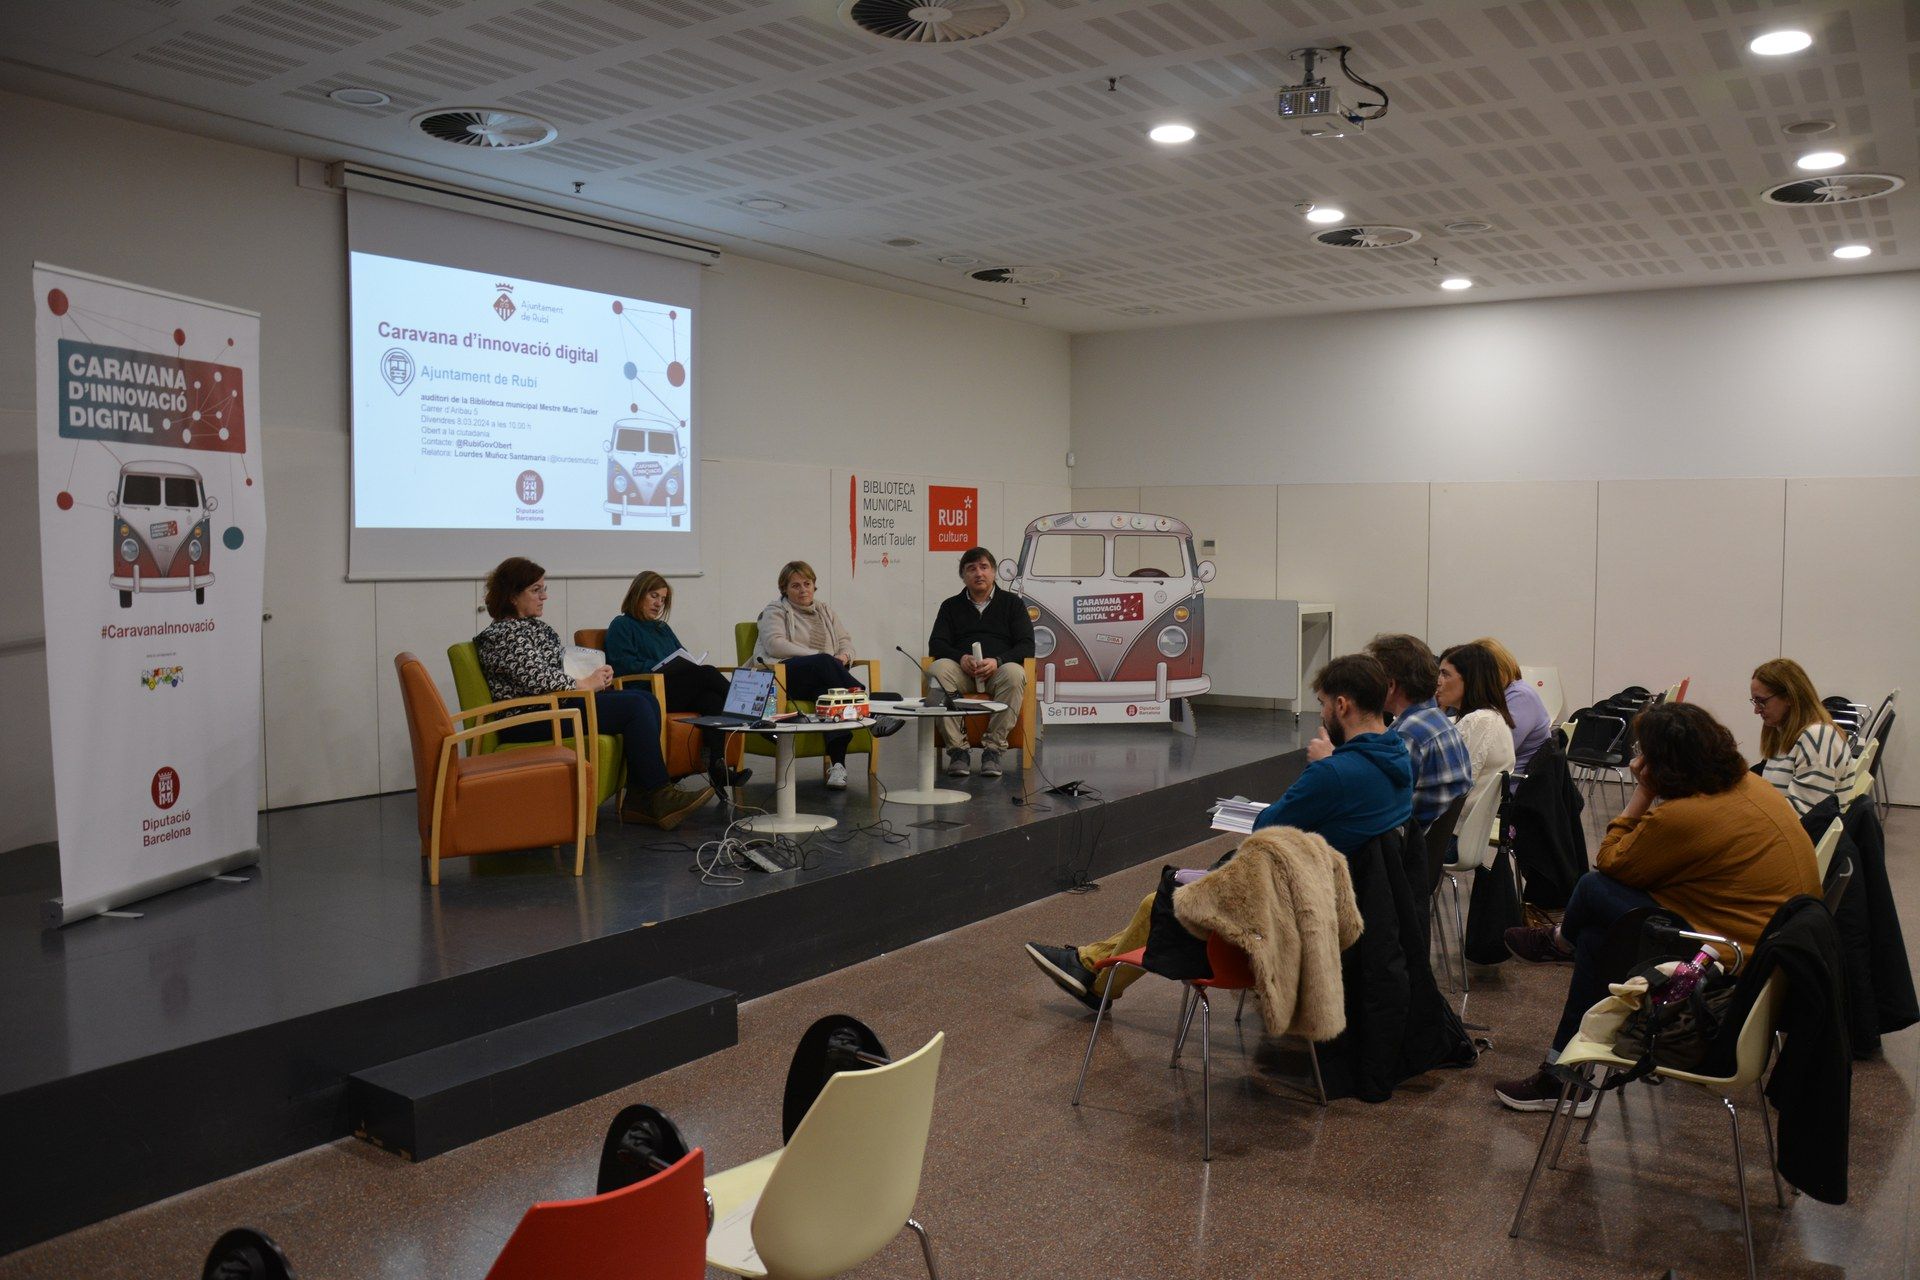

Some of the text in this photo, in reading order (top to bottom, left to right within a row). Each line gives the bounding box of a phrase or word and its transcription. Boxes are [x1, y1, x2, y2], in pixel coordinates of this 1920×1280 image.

[520, 300, 564, 314] Ajuntament
[520, 312, 531, 321] de
[378, 321, 458, 346] Caravana
[555, 344, 599, 364] digital
[68, 353, 187, 390] CARAVANA
[421, 365, 491, 384] Ajuntament
[494, 372, 508, 385] de
[421, 394, 449, 402] auditori
[462, 396, 468, 404] la
[470, 397, 504, 407] Biblioteca
[506, 401, 538, 411] municipal
[540, 403, 561, 412] Mestre
[580, 407, 598, 415] Tauler
[421, 404, 443, 413] Carrer
[69, 405, 154, 433] DIGITAL
[421, 415, 455, 424] Divendres
[421, 426, 441, 434] Obert
[455, 450, 483, 458] Lourdes
[509, 453, 546, 461] Santamaria
[863, 480, 916, 495] BIBLIOTECA
[863, 498, 913, 512] MUNICIPAL
[863, 516, 895, 528] Mestre
[863, 533, 916, 546] Martí Tauler
[939, 531, 968, 542] cultura
[1076, 597, 1121, 606] CARAVANA
[1077, 613, 1108, 621] DIGITAL
[101, 619, 215, 639] #CaravanaInnovació
[1048, 706, 1097, 717] SeTDIBA
[143, 809, 191, 831] Diputació
[143, 826, 191, 847] Barcelona
